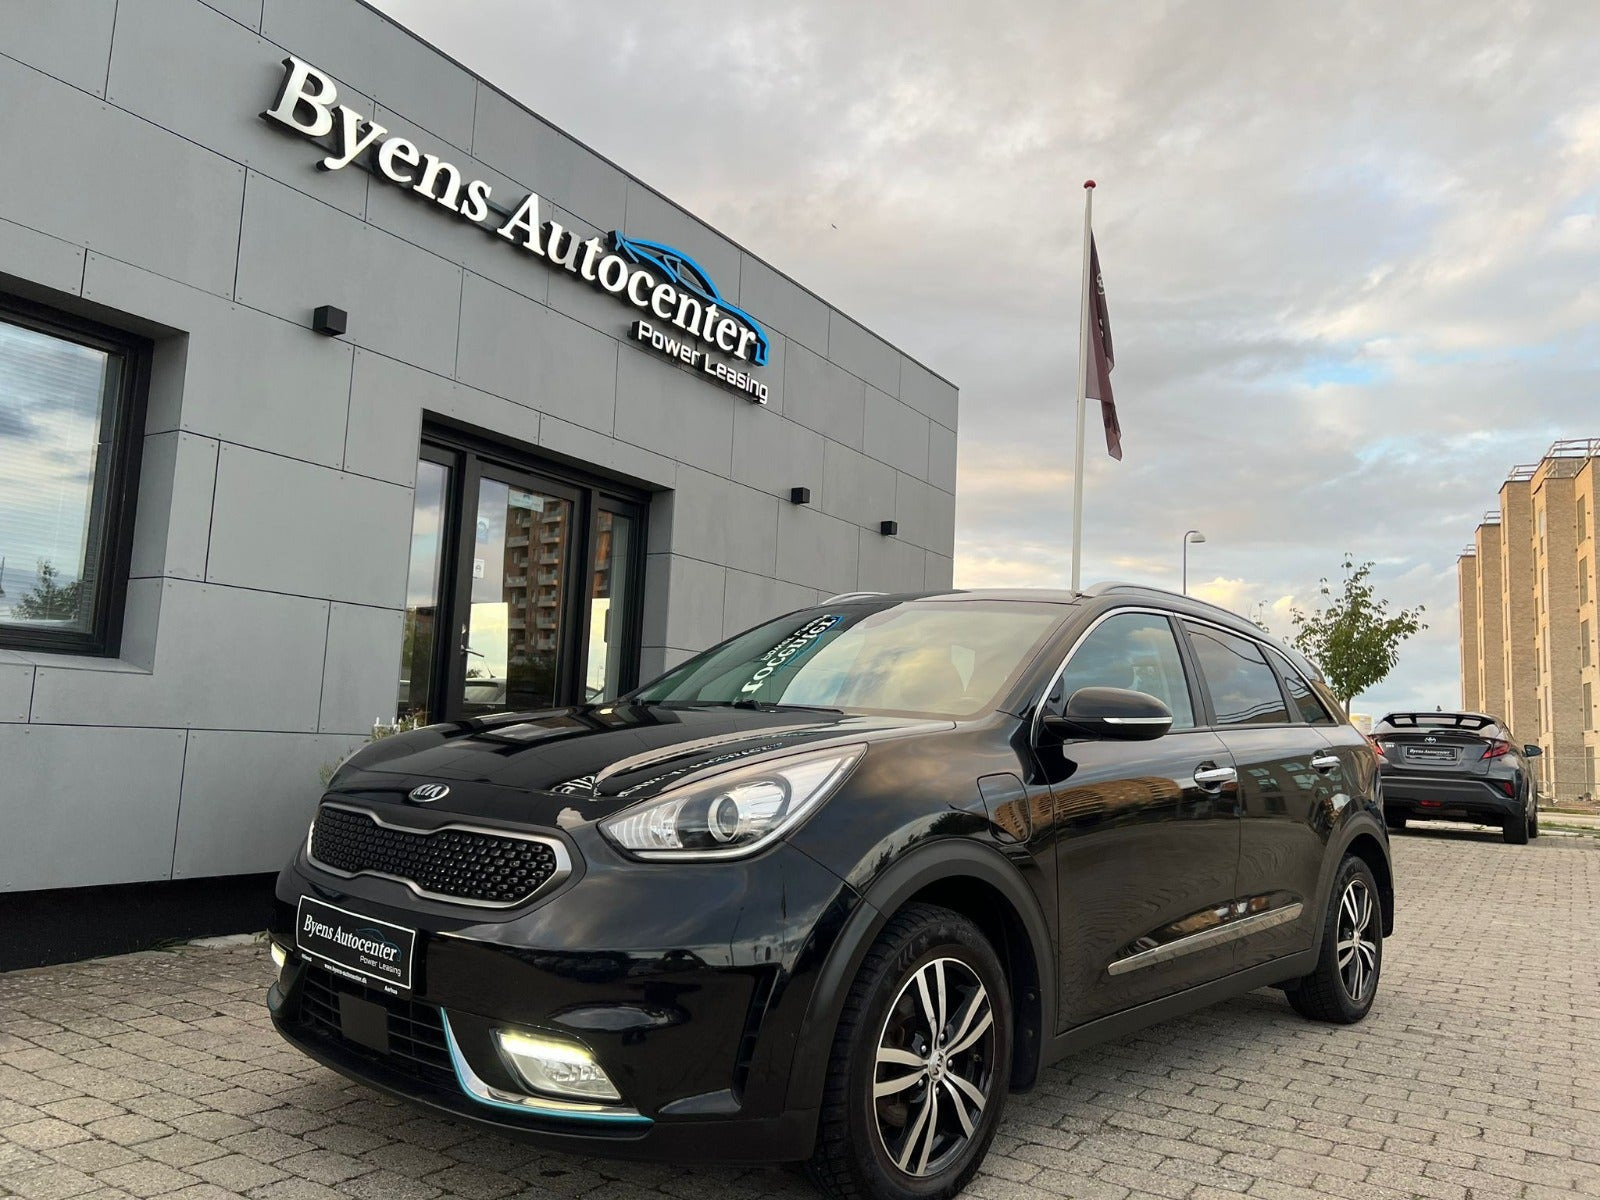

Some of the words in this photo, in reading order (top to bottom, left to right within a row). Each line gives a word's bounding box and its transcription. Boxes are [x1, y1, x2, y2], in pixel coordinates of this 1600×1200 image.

[263, 54, 493, 223] Byens
[497, 192, 757, 362] Autocenter
[637, 320, 701, 366] Power
[704, 356, 769, 404] Leasing
[412, 784, 443, 798] KIA
[303, 914, 334, 940] Byens
[333, 926, 398, 962] Autocenter
[359, 955, 378, 968] Power
[379, 961, 402, 977] Leasing
